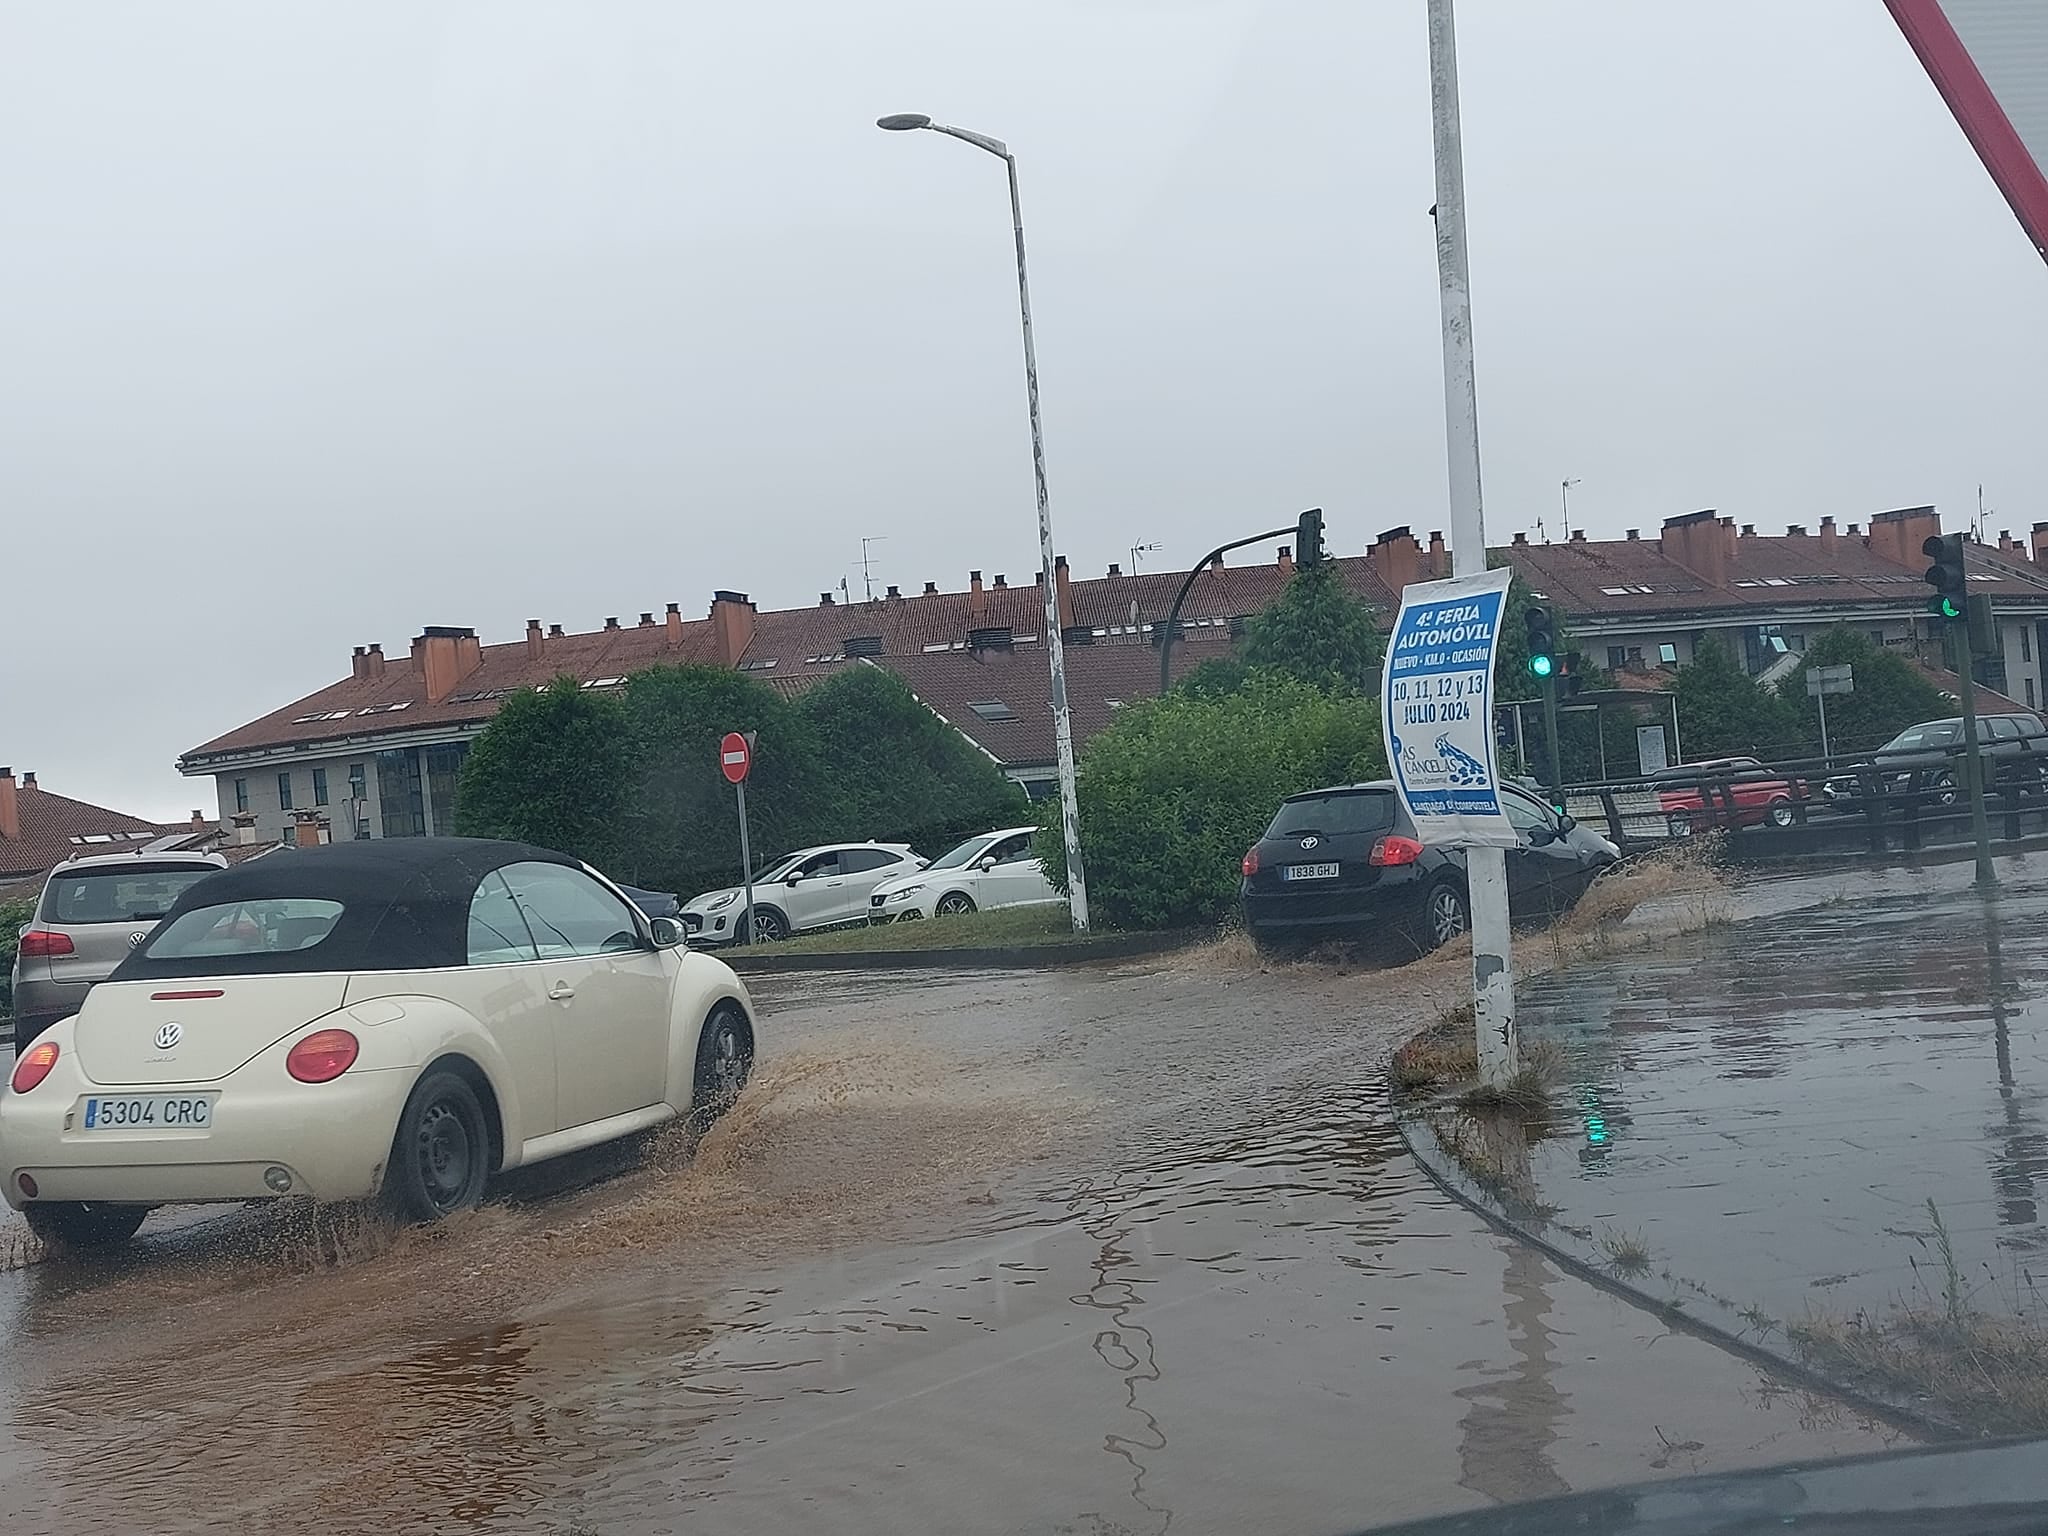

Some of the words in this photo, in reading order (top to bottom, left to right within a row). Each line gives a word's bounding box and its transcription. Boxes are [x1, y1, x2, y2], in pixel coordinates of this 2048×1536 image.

[1435, 604, 1480, 626] FERIA
[1397, 622, 1492, 650] AUTOMÓVIL
[1393, 655, 1418, 670] NUEVO
[1452, 645, 1489, 664] OCASIÓN
[1394, 682, 1410, 703] 10,
[1415, 680, 1432, 702] 11,
[1437, 677, 1452, 697] 12
[1456, 680, 1464, 699] y
[1467, 675, 1483, 694] 13
[1404, 703, 1436, 725] JULIO
[1440, 701, 1470, 721] 2024
[1405, 758, 1457, 774] CANCELAS
[1317, 864, 1337, 876] GHJ
[101, 1100, 154, 1124] 5304
[164, 1100, 207, 1123] CRC
